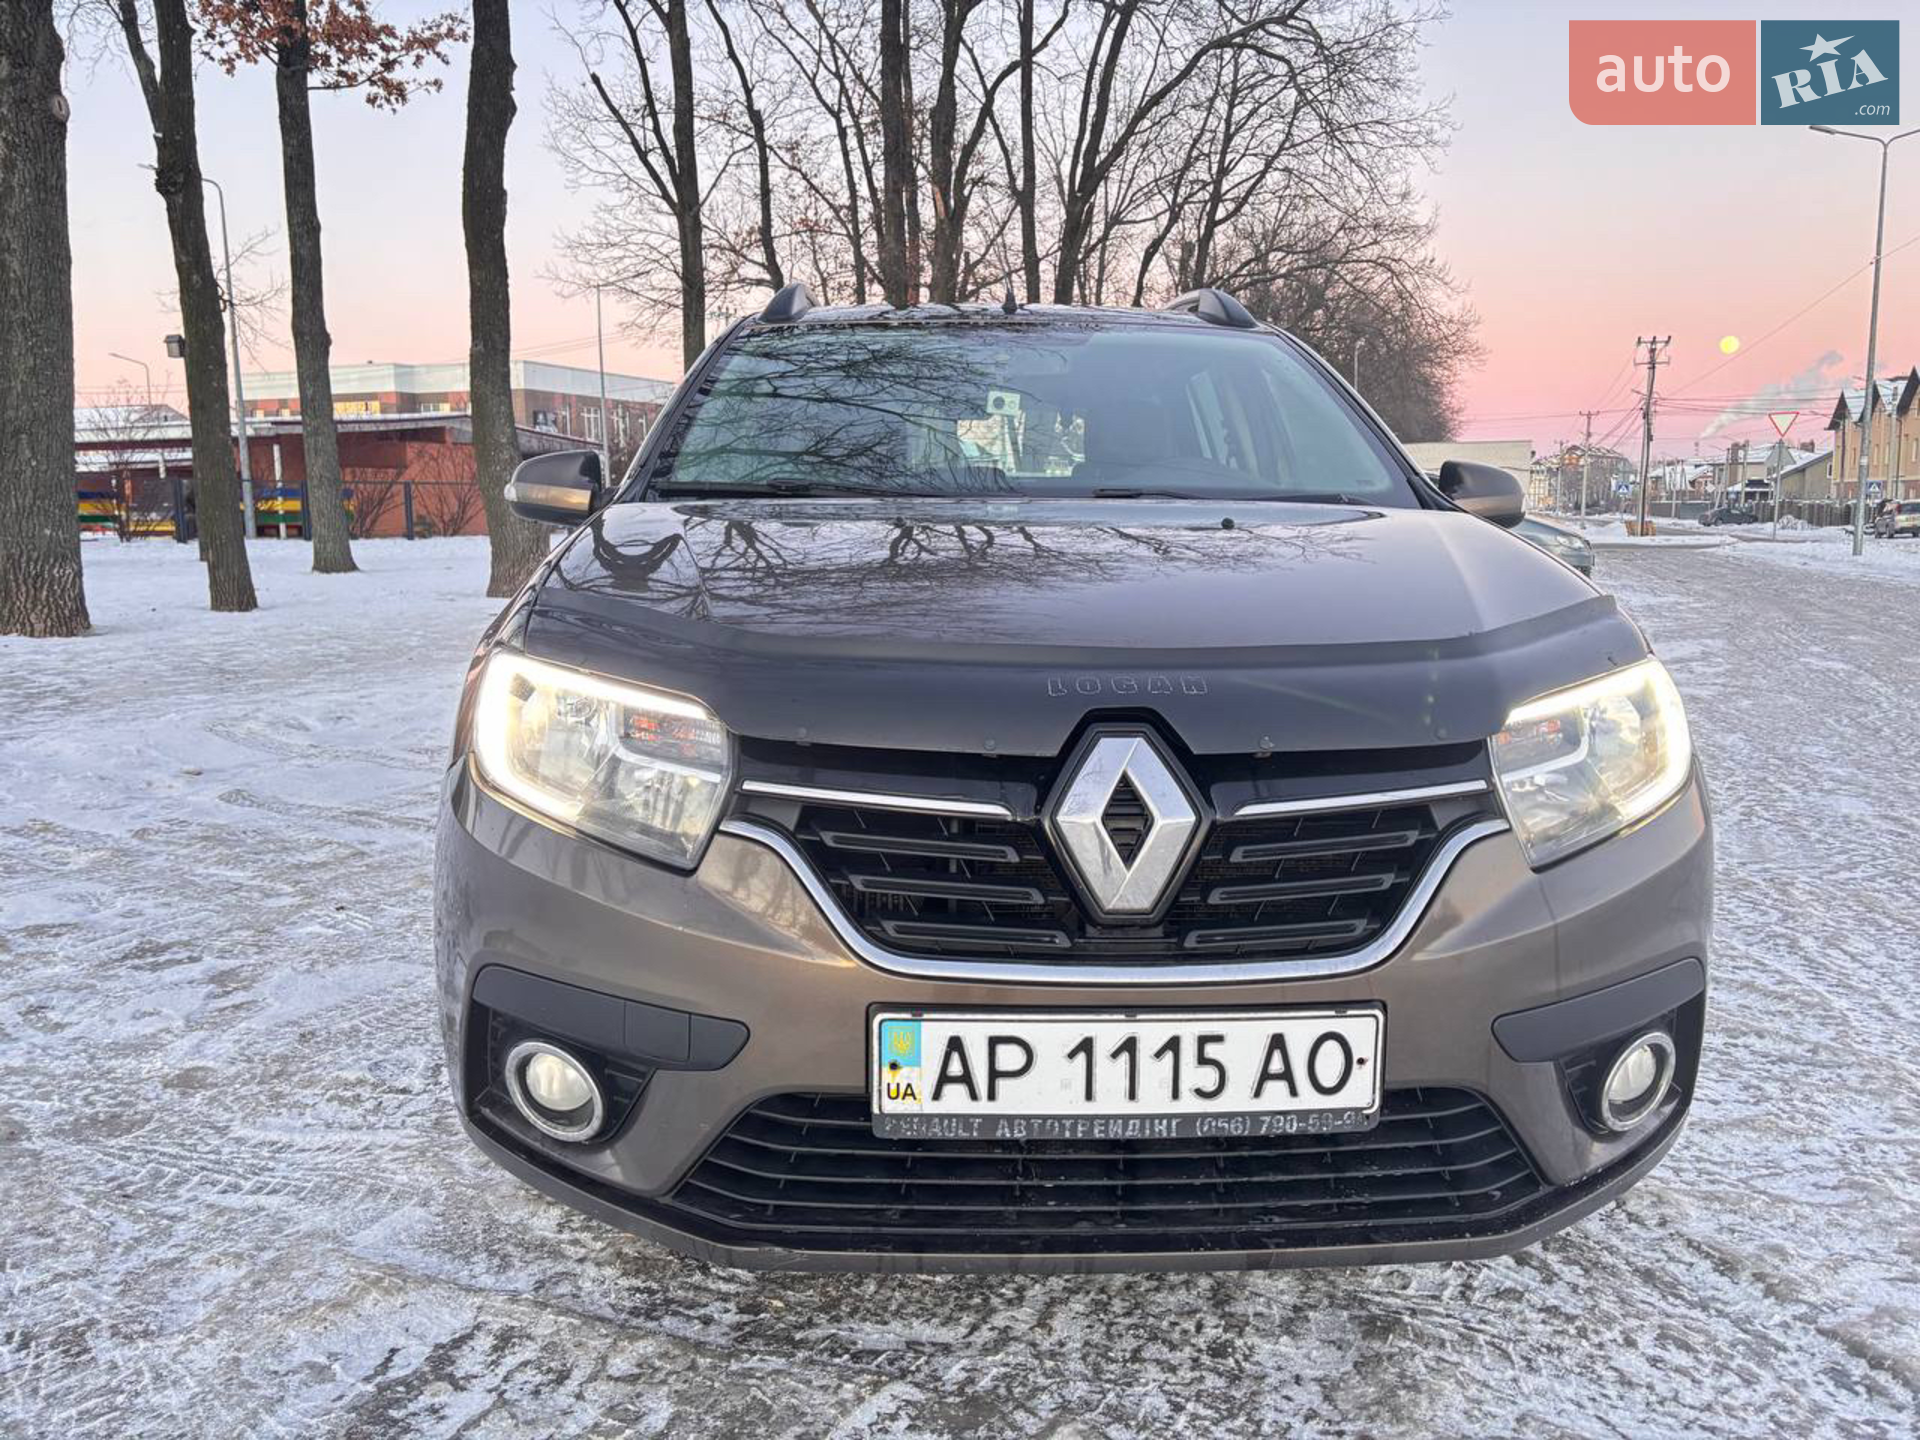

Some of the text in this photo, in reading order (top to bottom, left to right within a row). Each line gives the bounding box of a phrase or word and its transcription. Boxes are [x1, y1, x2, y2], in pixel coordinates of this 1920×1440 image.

[1047, 675, 1208, 697] LOGAN
[931, 1031, 1354, 1101] AP 1115 AO
[887, 1082, 917, 1100] UA
